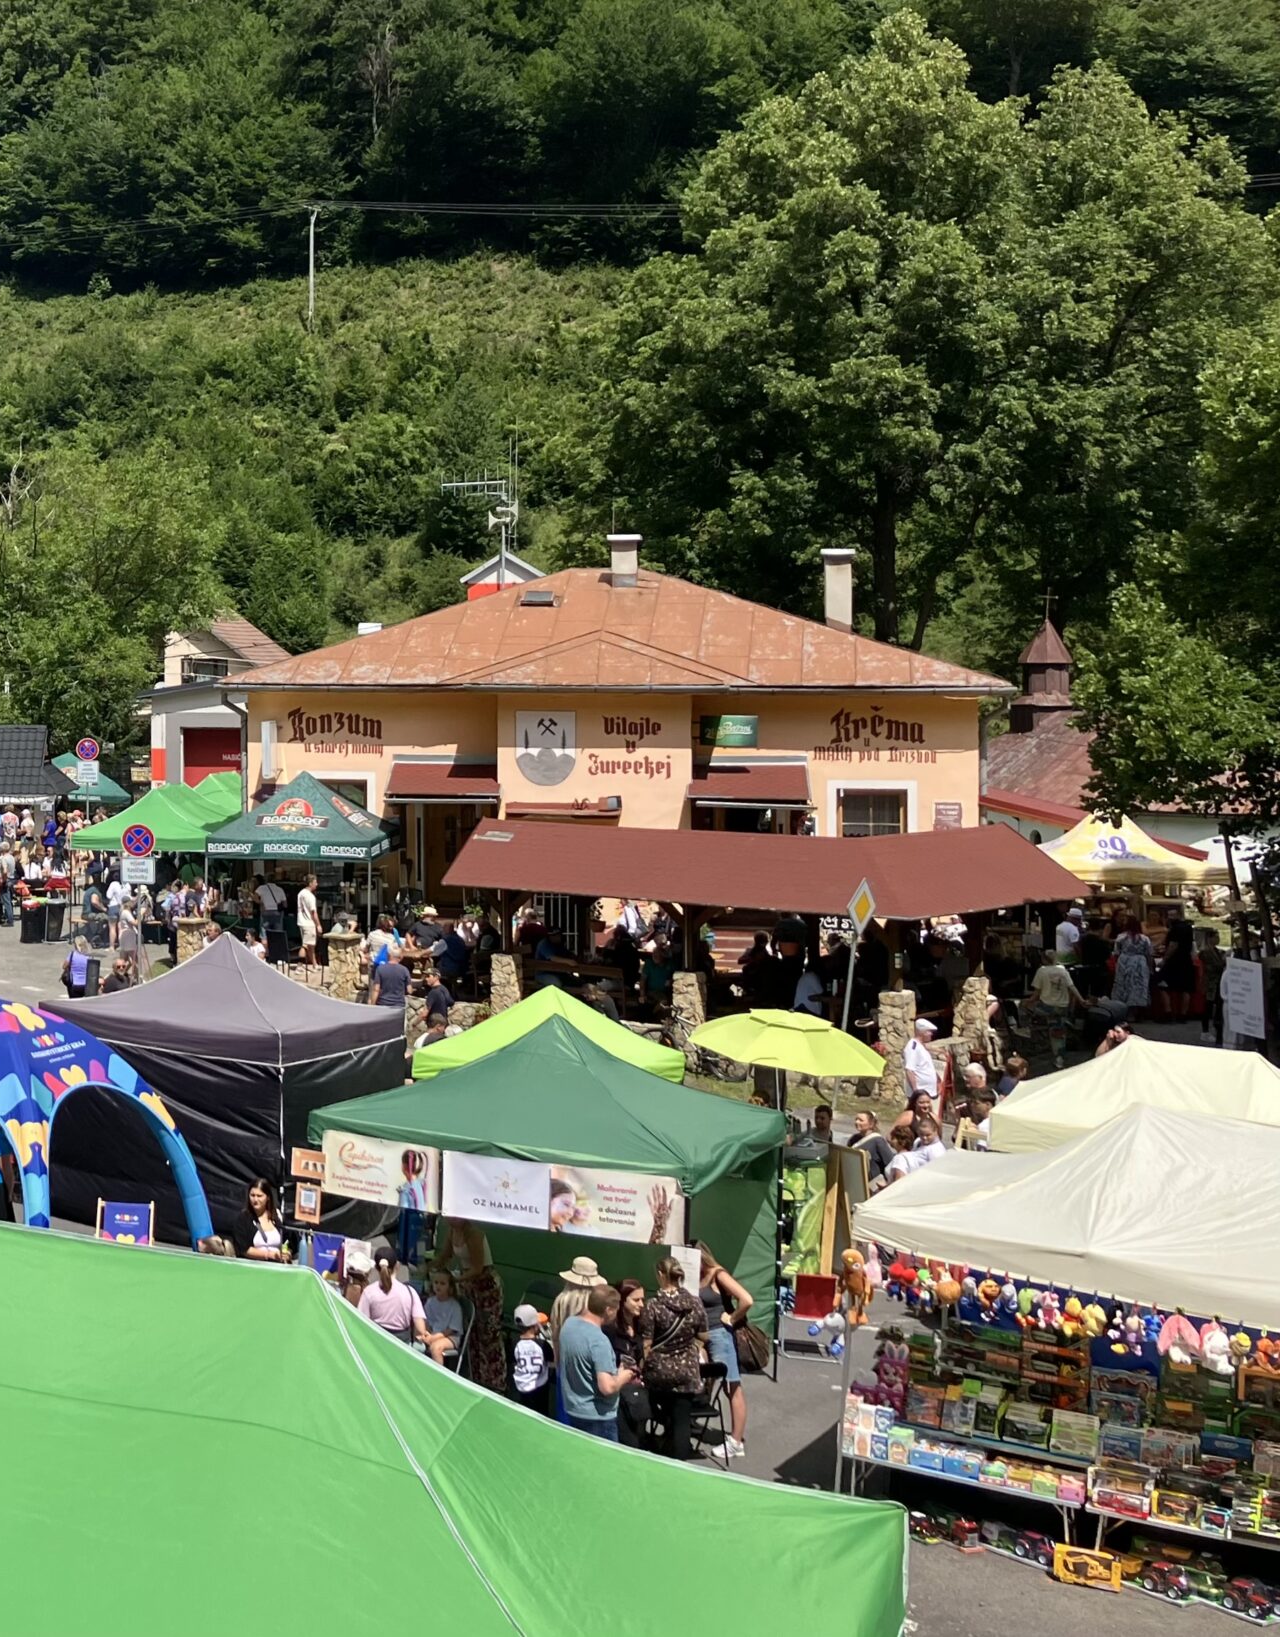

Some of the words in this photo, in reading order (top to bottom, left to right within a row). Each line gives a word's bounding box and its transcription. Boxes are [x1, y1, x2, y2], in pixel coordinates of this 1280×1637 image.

[287, 706, 383, 743] Konzum
[261, 815, 325, 827] RADEGAST
[207, 843, 253, 854] RADEGAST
[263, 843, 310, 854] RADEGAST
[320, 845, 368, 858] RADEGAST
[473, 1198, 486, 1207] OZ
[489, 1200, 540, 1215] HAMAMEL
